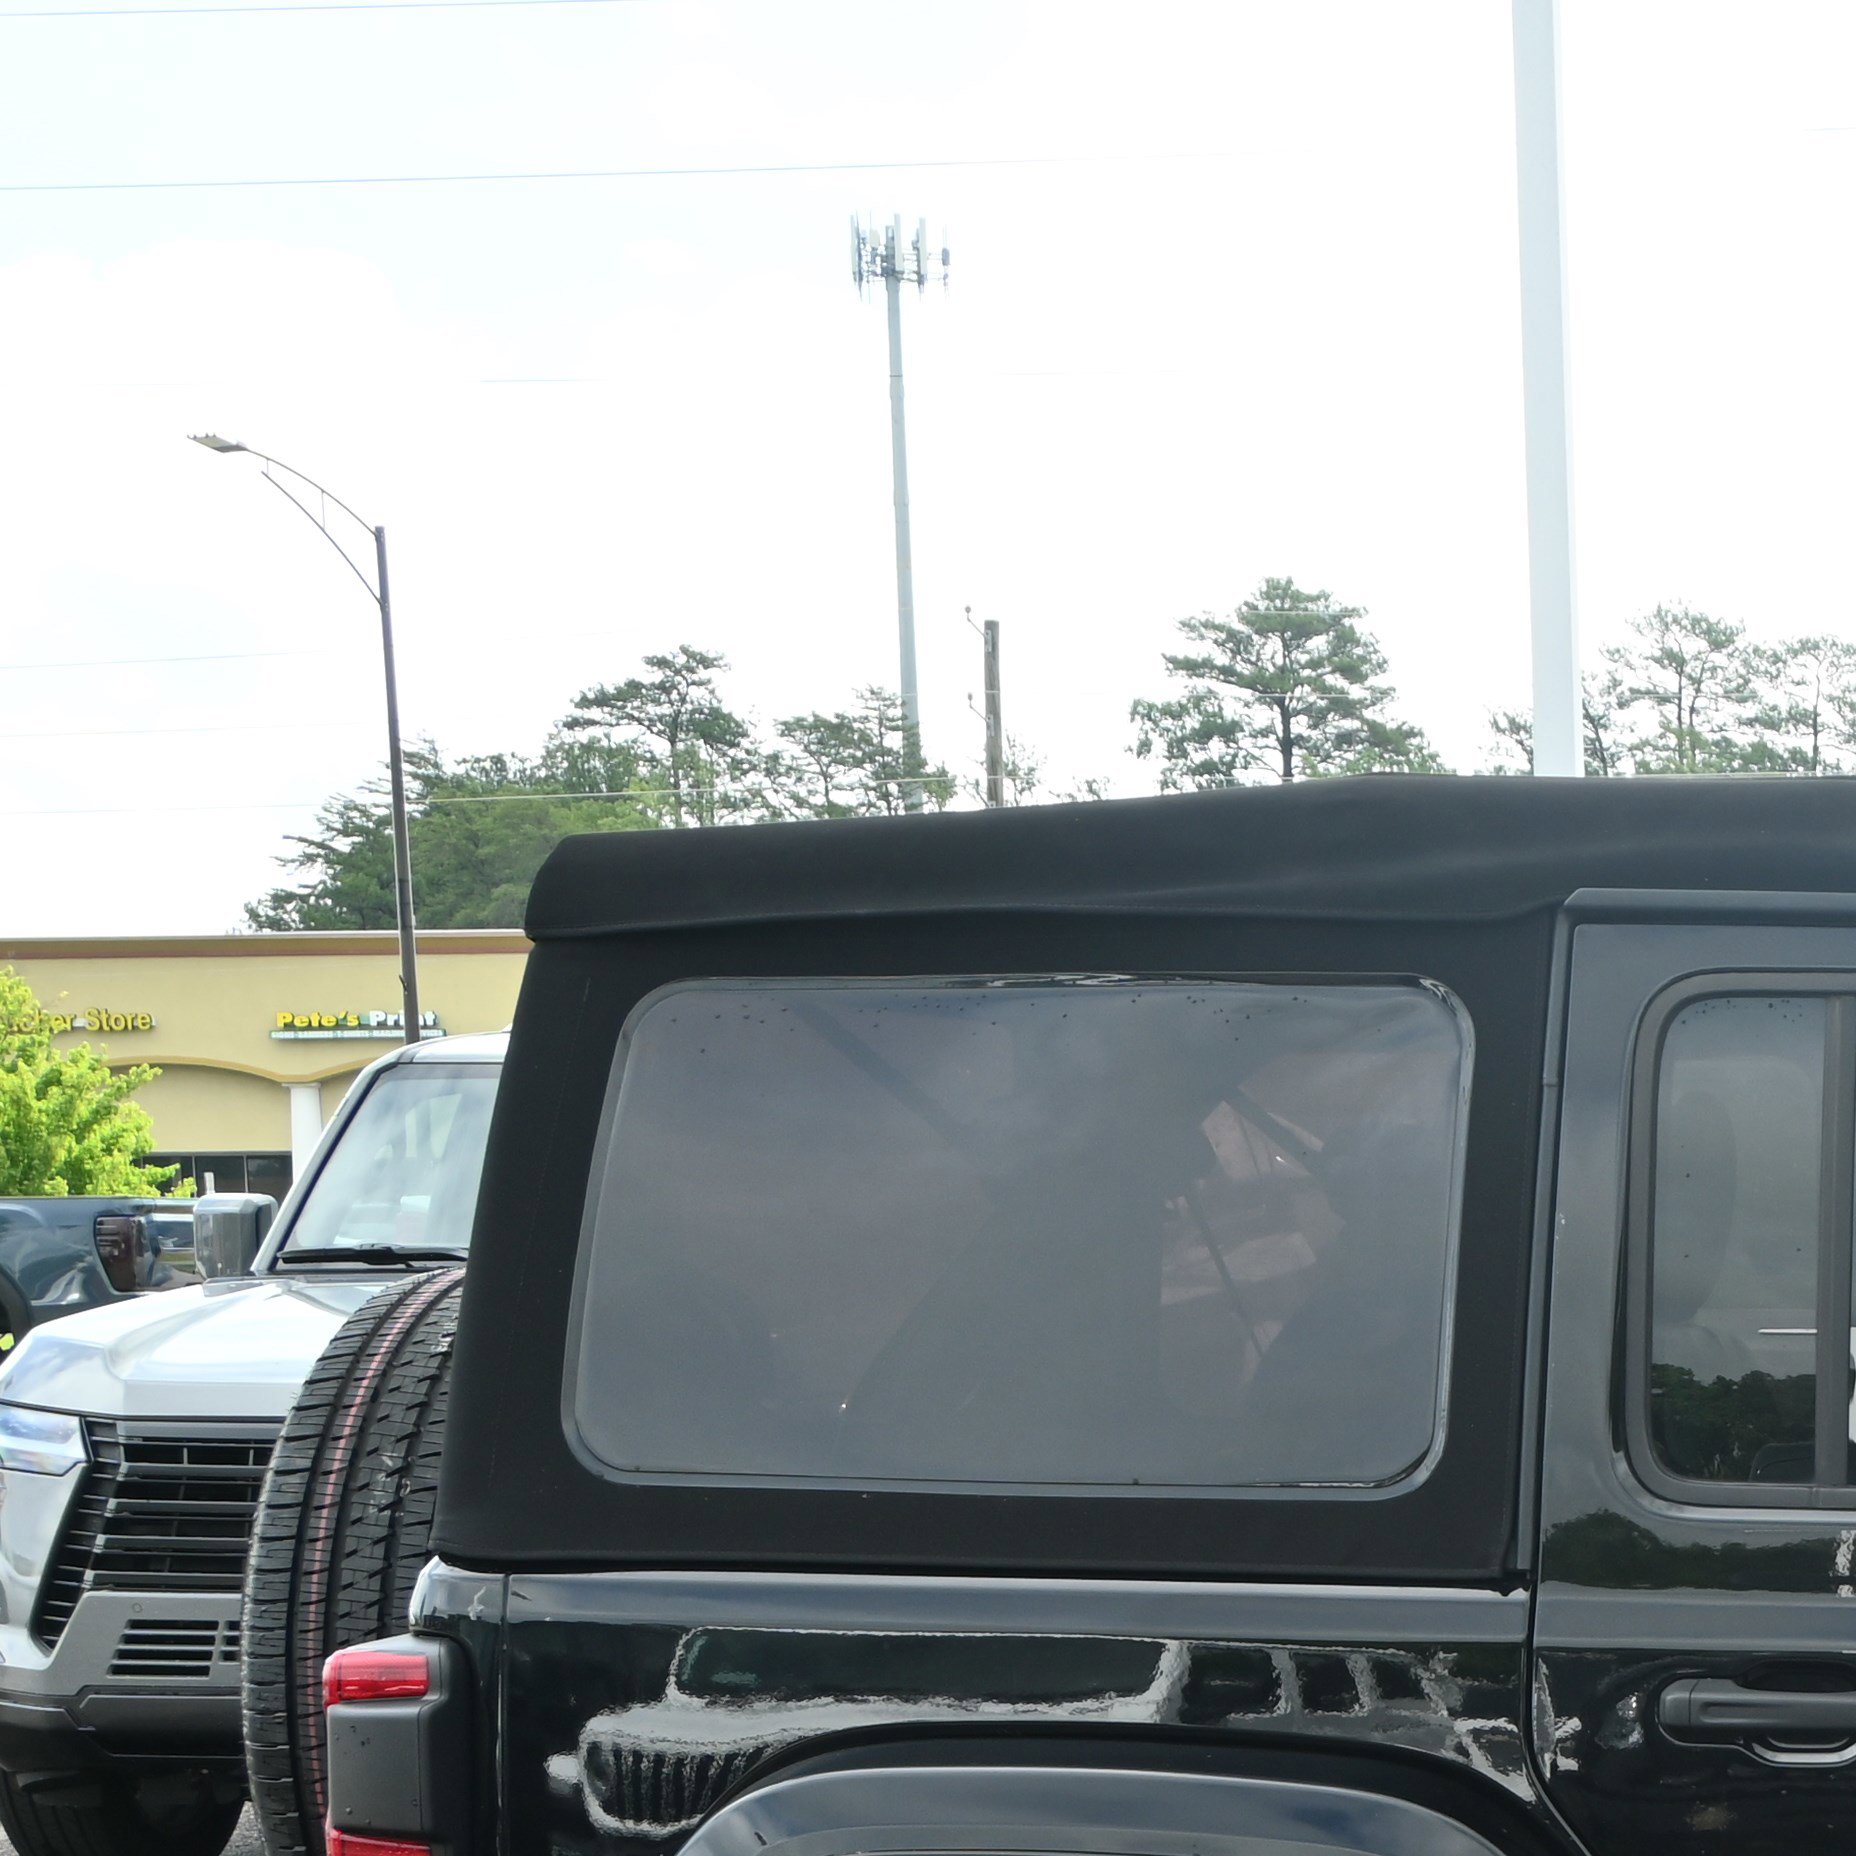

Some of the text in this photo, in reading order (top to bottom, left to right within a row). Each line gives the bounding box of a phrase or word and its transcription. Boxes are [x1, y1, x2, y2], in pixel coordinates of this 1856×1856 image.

[84, 1007, 153, 1032] Store
[276, 1008, 437, 1028] Pete's Prit
